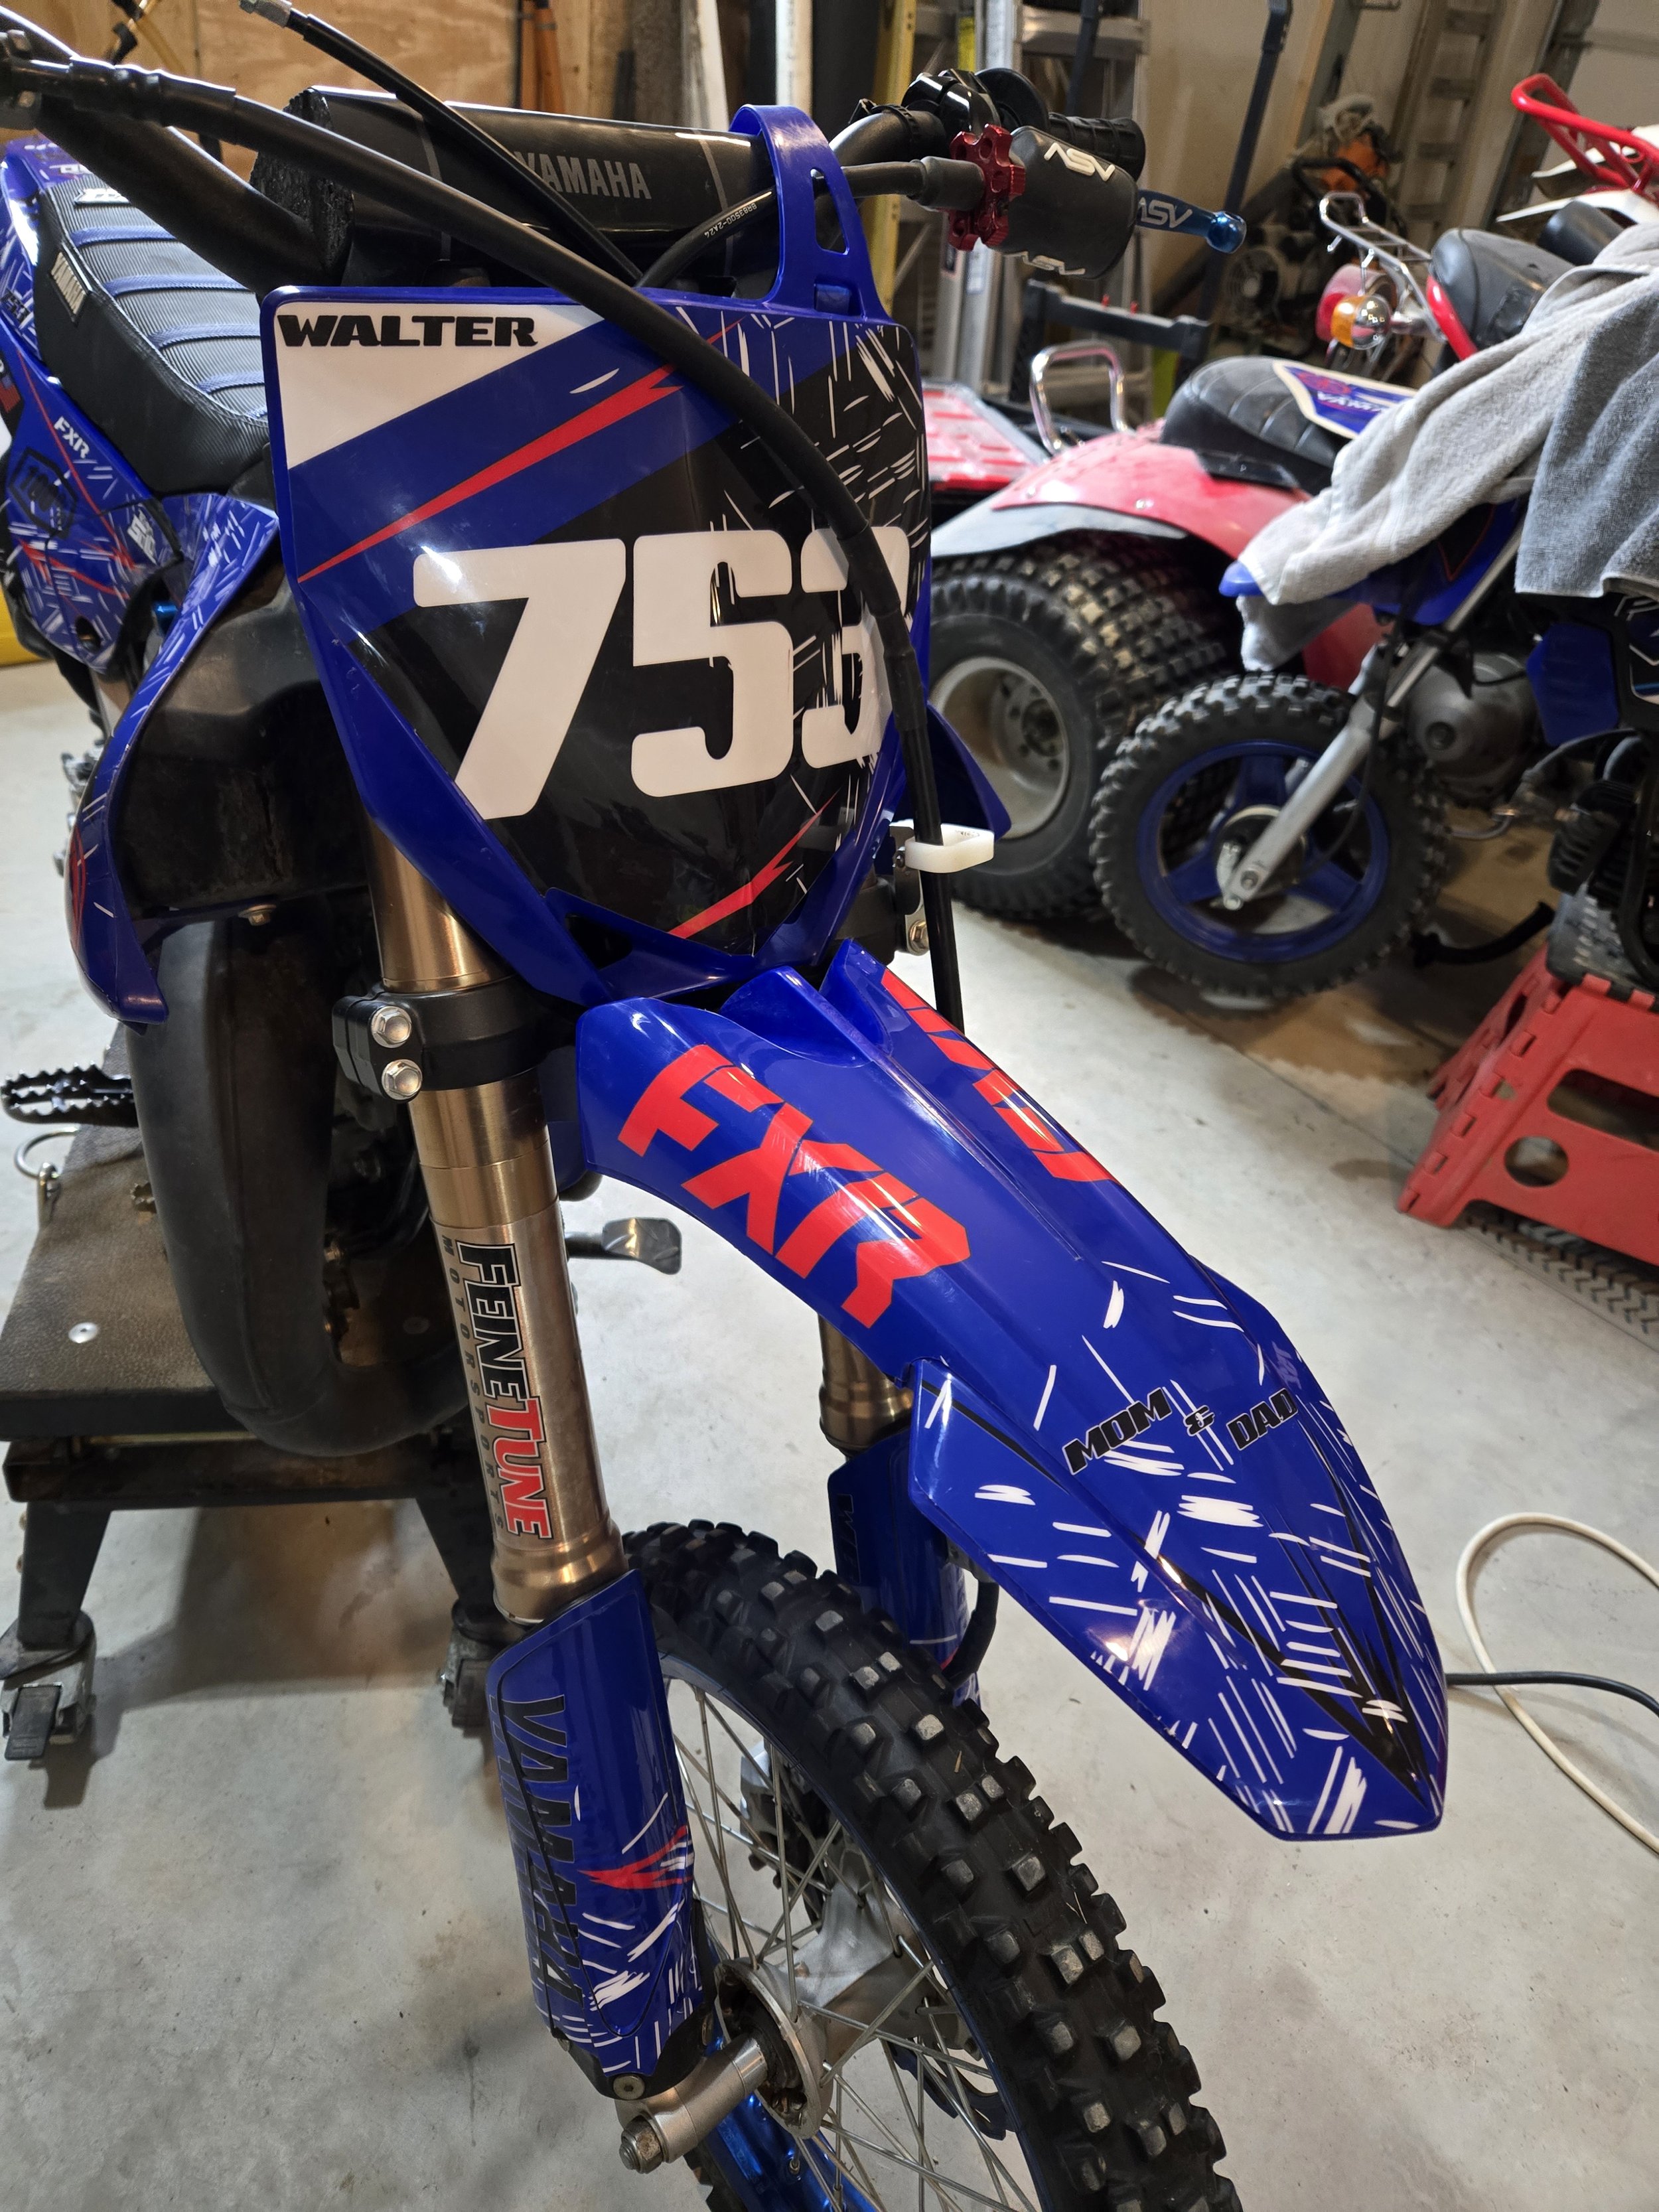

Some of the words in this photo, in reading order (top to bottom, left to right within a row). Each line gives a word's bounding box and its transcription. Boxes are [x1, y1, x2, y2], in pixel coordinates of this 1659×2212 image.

[514, 151, 652, 199] YAMAHA
[1044, 142, 1116, 182] ASV
[277, 315, 538, 347] WALTER
[54, 416, 90, 459] FXR
[413, 526, 911, 821] 753
[618, 1044, 972, 1329] FXR
[1062, 1386, 1173, 1475] MOM
[1183, 1404, 1215, 1437] &
[1226, 1388, 1299, 1451] DAD
[489, 1694, 585, 2012] YAMAHA
